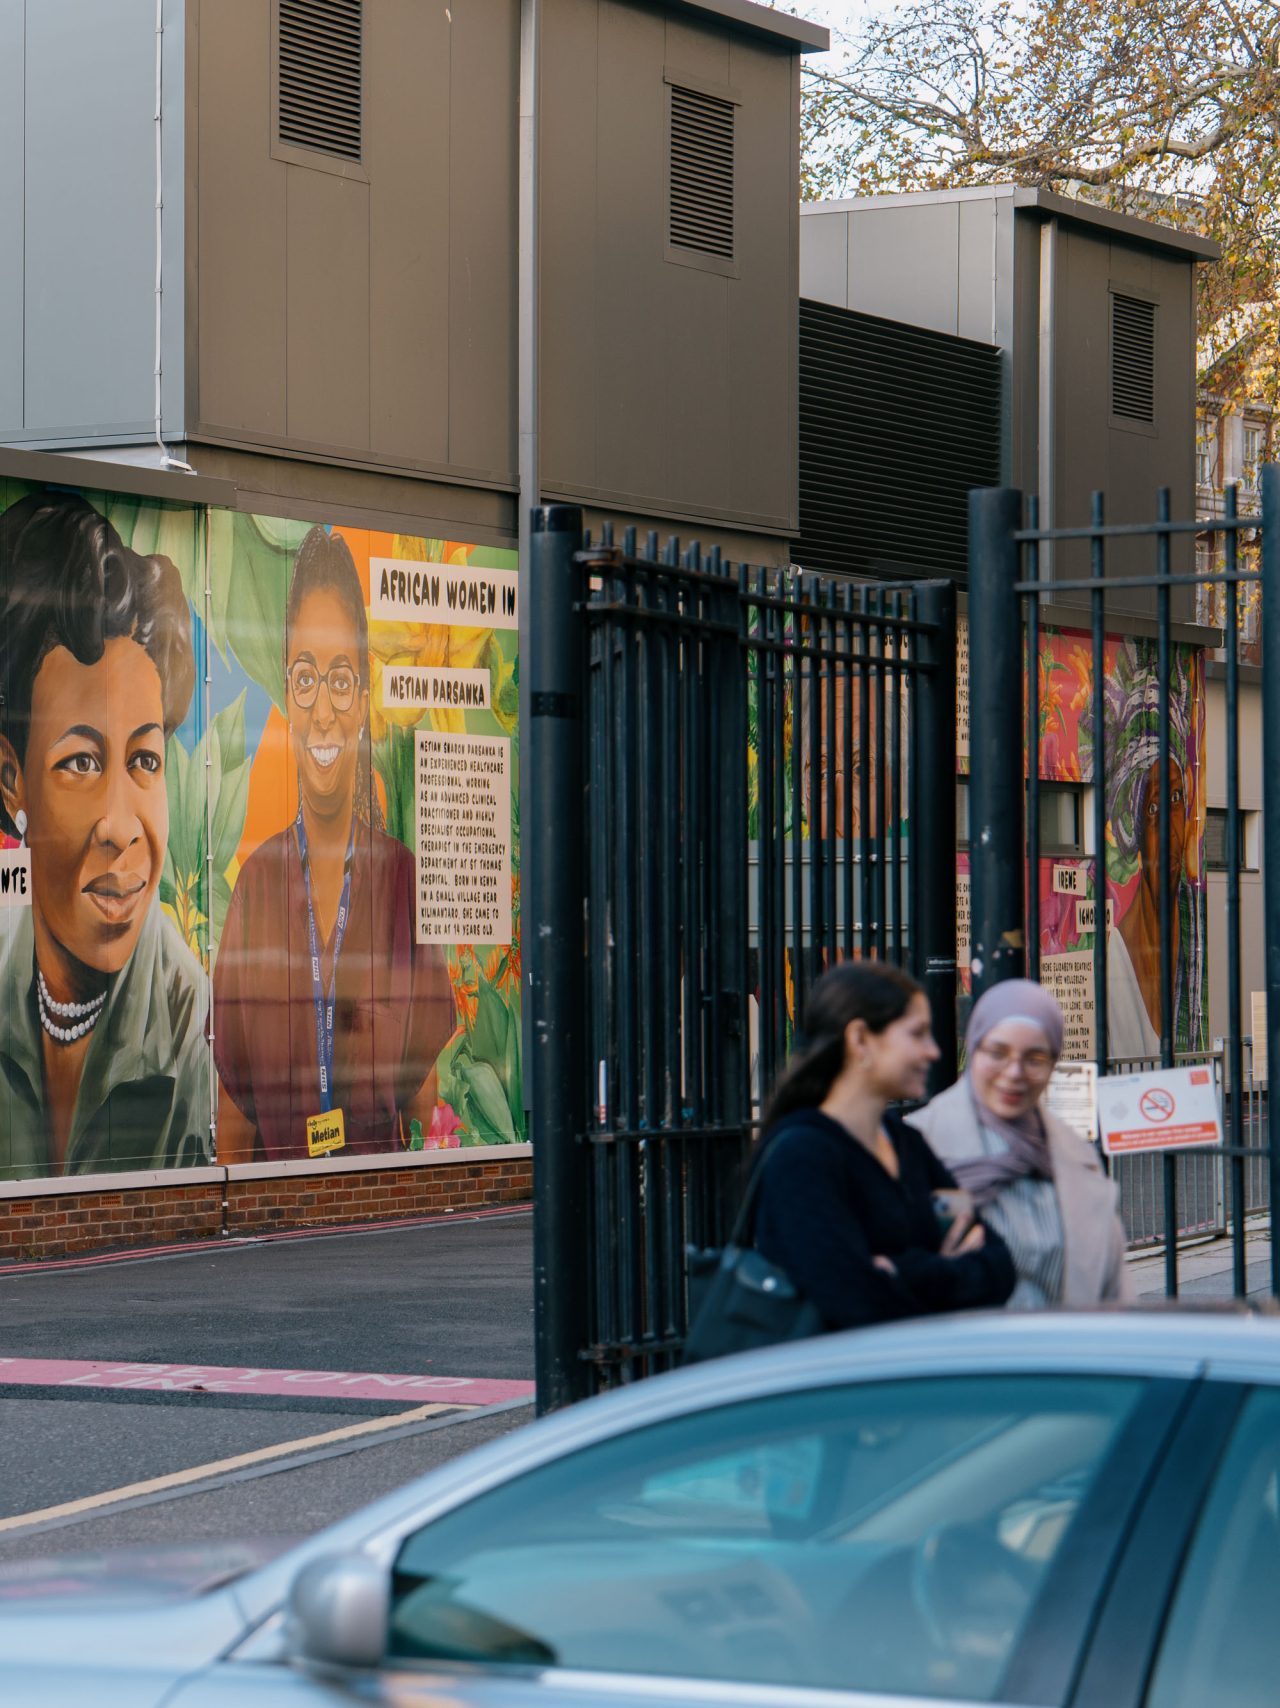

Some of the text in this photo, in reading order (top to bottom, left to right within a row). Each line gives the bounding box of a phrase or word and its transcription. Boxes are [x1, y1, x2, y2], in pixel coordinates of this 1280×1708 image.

[380, 568, 515, 616] AFRICAN WOMEN IN
[390, 675, 485, 706] METIAN PARSANKA
[419, 740, 503, 758] METIAN SHARON PARSANKA IS
[419, 757, 503, 774] AN EXPERIENCED HEALTHCARE
[465, 777, 490, 789] WORKING
[420, 790, 496, 805] AS AN ADVANCED CLINICAL
[420, 806, 494, 822] PRACTITIONER AND HIGHLY
[420, 823, 496, 838] SPECIALIST OCCUPATIONAL
[1058, 871, 1077, 890] IRENE
[1079, 906, 1110, 925] IGHOO
[311, 1126, 339, 1144] Metian
[59, 1373, 256, 1392] LINE
[106, 1363, 475, 1388] BEYOND
